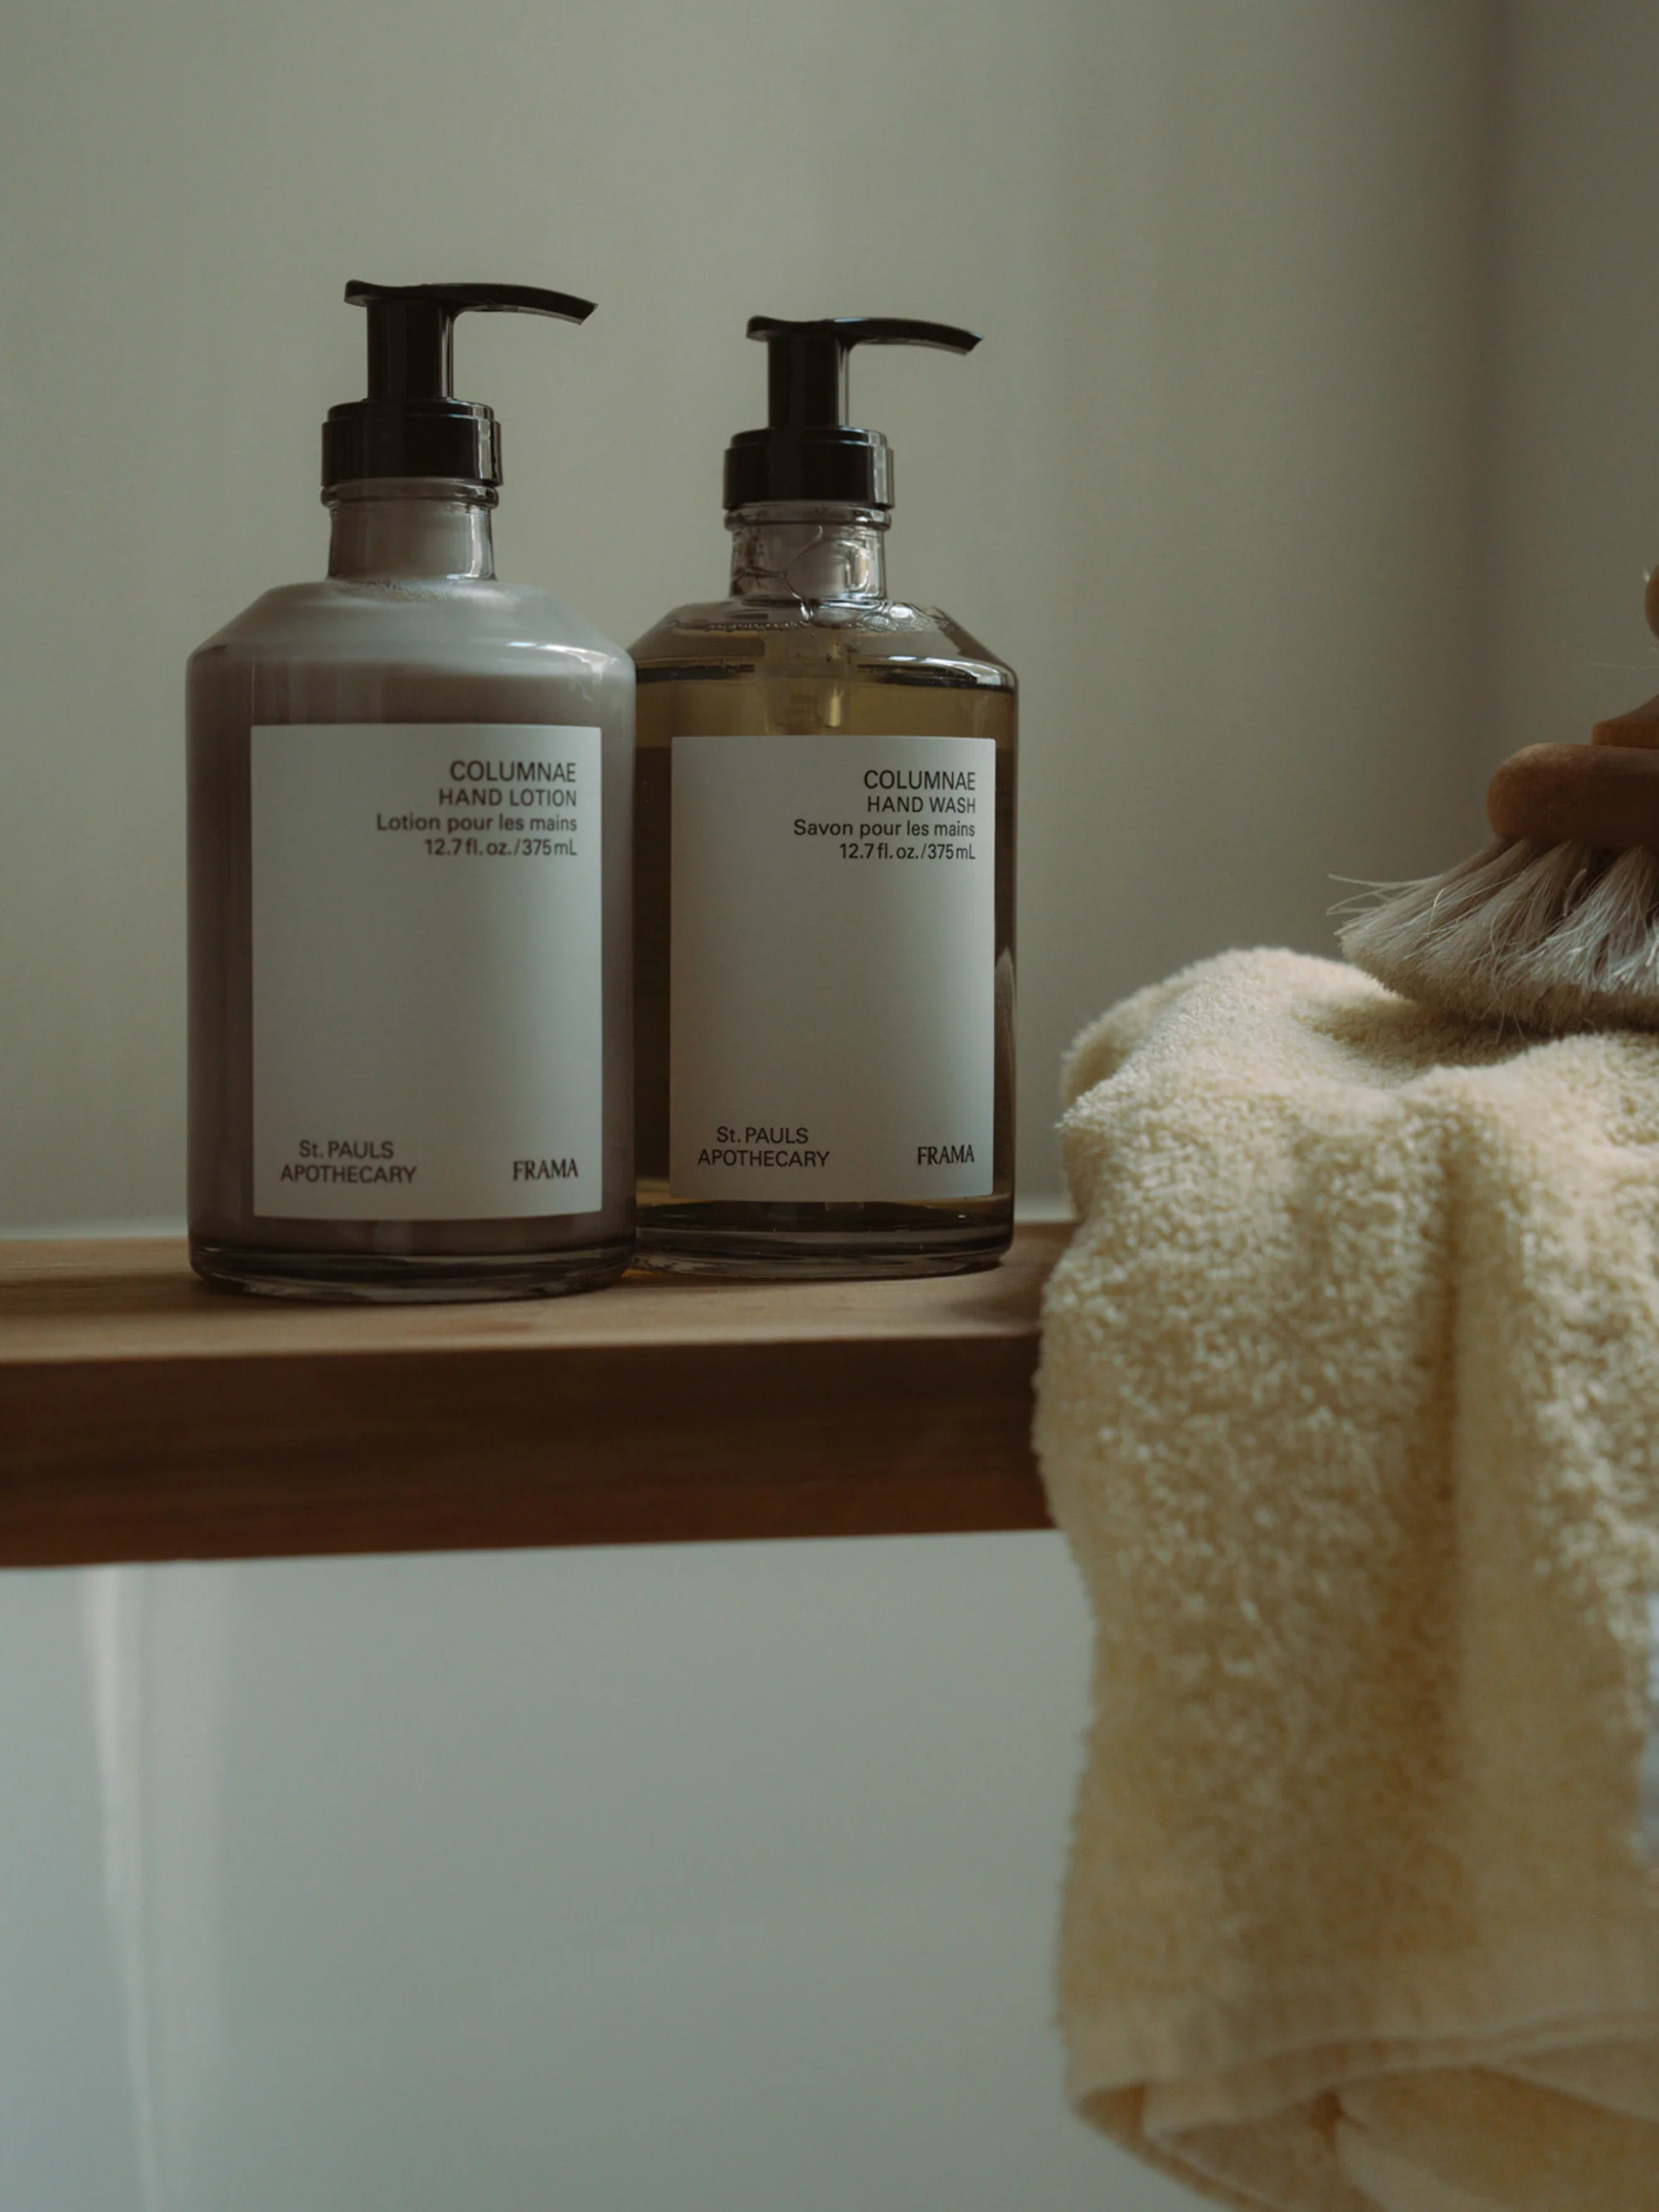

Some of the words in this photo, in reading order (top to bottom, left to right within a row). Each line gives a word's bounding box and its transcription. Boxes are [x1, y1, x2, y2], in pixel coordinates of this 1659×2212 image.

[450, 760, 576, 783] COLUMNAE
[864, 770, 975, 791] COLUMNAE
[439, 788, 503, 806] HAND
[509, 788, 577, 807] LOTION
[868, 795, 923, 813] HAND
[929, 796, 975, 814] WASH
[377, 812, 441, 831] Lotion
[447, 817, 494, 835] pour
[499, 813, 524, 831] les
[529, 814, 577, 832] mains
[794, 819, 853, 836] Savon
[859, 824, 902, 839] pour
[907, 819, 929, 837] les
[934, 820, 975, 837] mains
[717, 1125, 741, 1143] St.
[745, 1126, 809, 1145] PAULS
[299, 1139, 324, 1159] St.
[328, 1140, 394, 1160] PAULS
[698, 1149, 830, 1168] APOTHECARY
[917, 1144, 975, 1165] FRAMA
[280, 1164, 417, 1184] APOTHECARY
[513, 1158, 579, 1181] FRAMA
